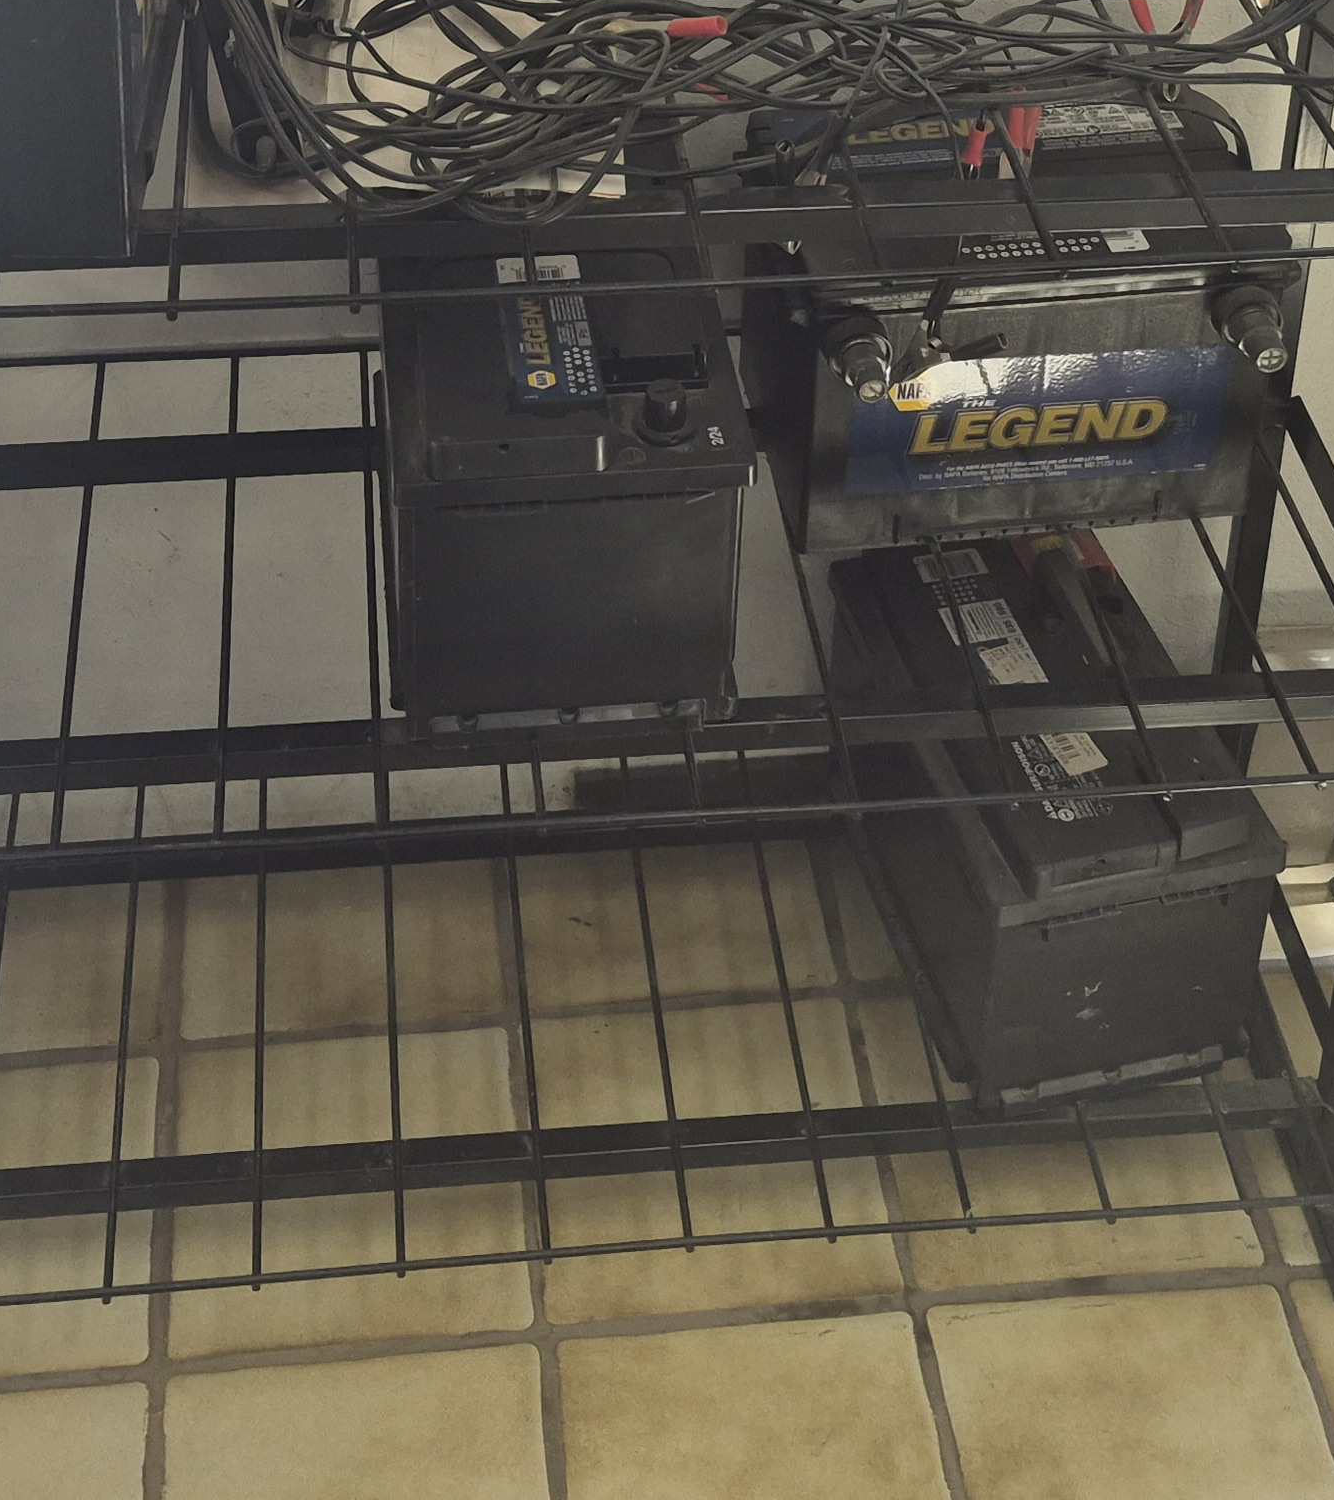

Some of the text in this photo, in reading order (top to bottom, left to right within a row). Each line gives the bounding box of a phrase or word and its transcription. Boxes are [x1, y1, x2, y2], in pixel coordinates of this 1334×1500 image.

[521, 298, 551, 365] LEGEN
[962, 399, 996, 408] THE
[707, 427, 724, 446] 2/24
[909, 398, 1167, 455] LEGEND
